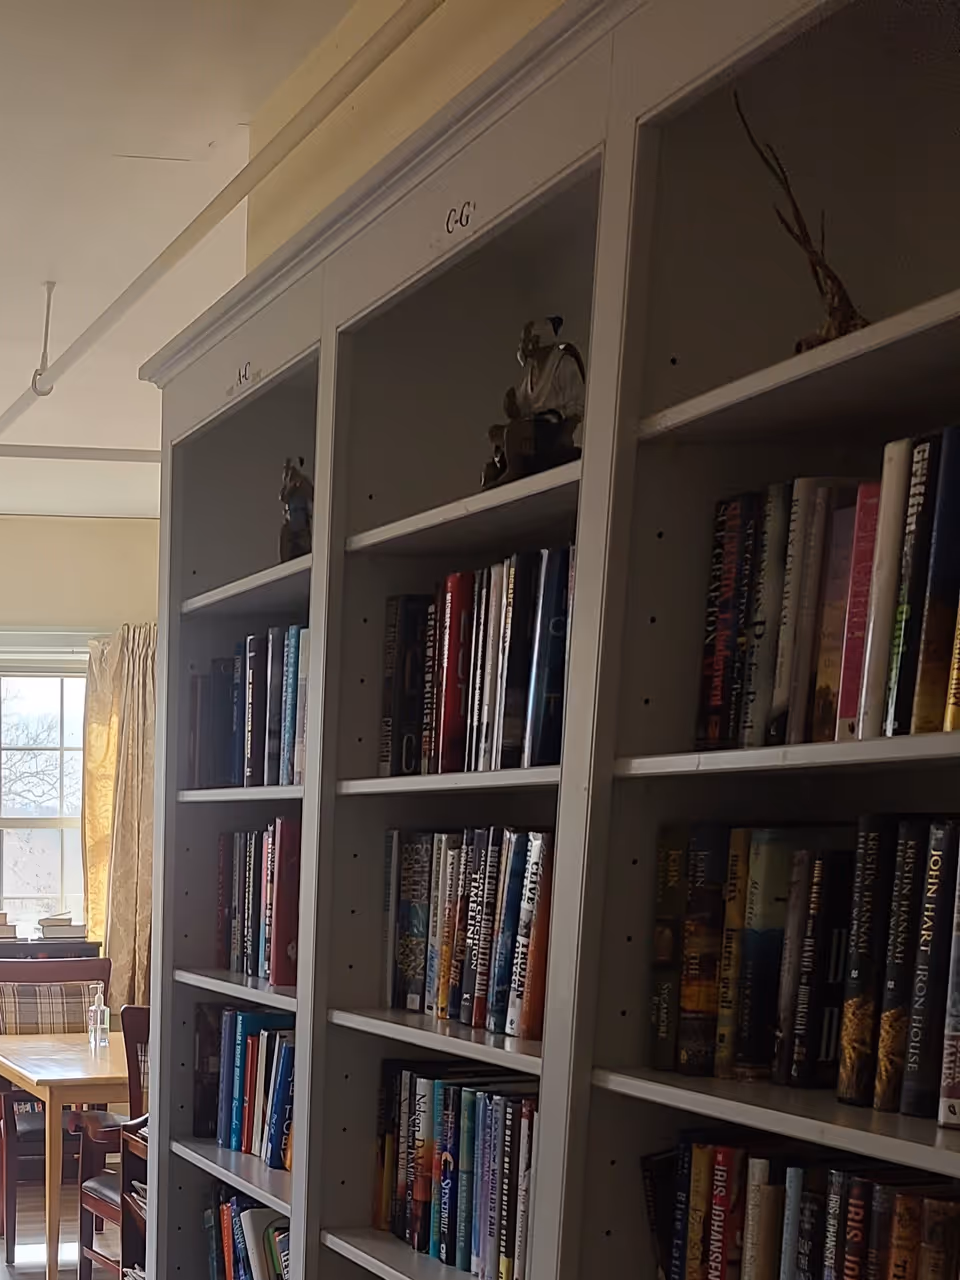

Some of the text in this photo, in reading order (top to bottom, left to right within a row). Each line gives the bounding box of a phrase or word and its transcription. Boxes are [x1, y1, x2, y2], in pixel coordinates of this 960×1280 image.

[905, 442, 930, 534] Griffin
[525, 861, 540, 905] CLIVE
[857, 831, 880, 956] KRISTIN HANNAH
[893, 839, 917, 965] KRISTIN HANNAH
[465, 869, 481, 949] TIMELINE
[470, 849, 487, 971] MICHAEL CRICHTON
[449, 959, 461, 989] FIRE
[514, 942, 530, 1001] TROJAN
[906, 849, 943, 1072] JOHN HART IRON HOUSE
[415, 1092, 428, 1133] Nelson
[405, 1148, 416, 1185] DeMille
[712, 1164, 728, 1198] IRIS
[440, 1176, 452, 1235] SPENCERVILLE
[487, 1213, 497, 1239] FAIR
[673, 1191, 687, 1231] Blue
[828, 1193, 840, 1214] IRIS
[845, 1197, 865, 1242] IRIS
[823, 1213, 839, 1268] JOHANSEN
